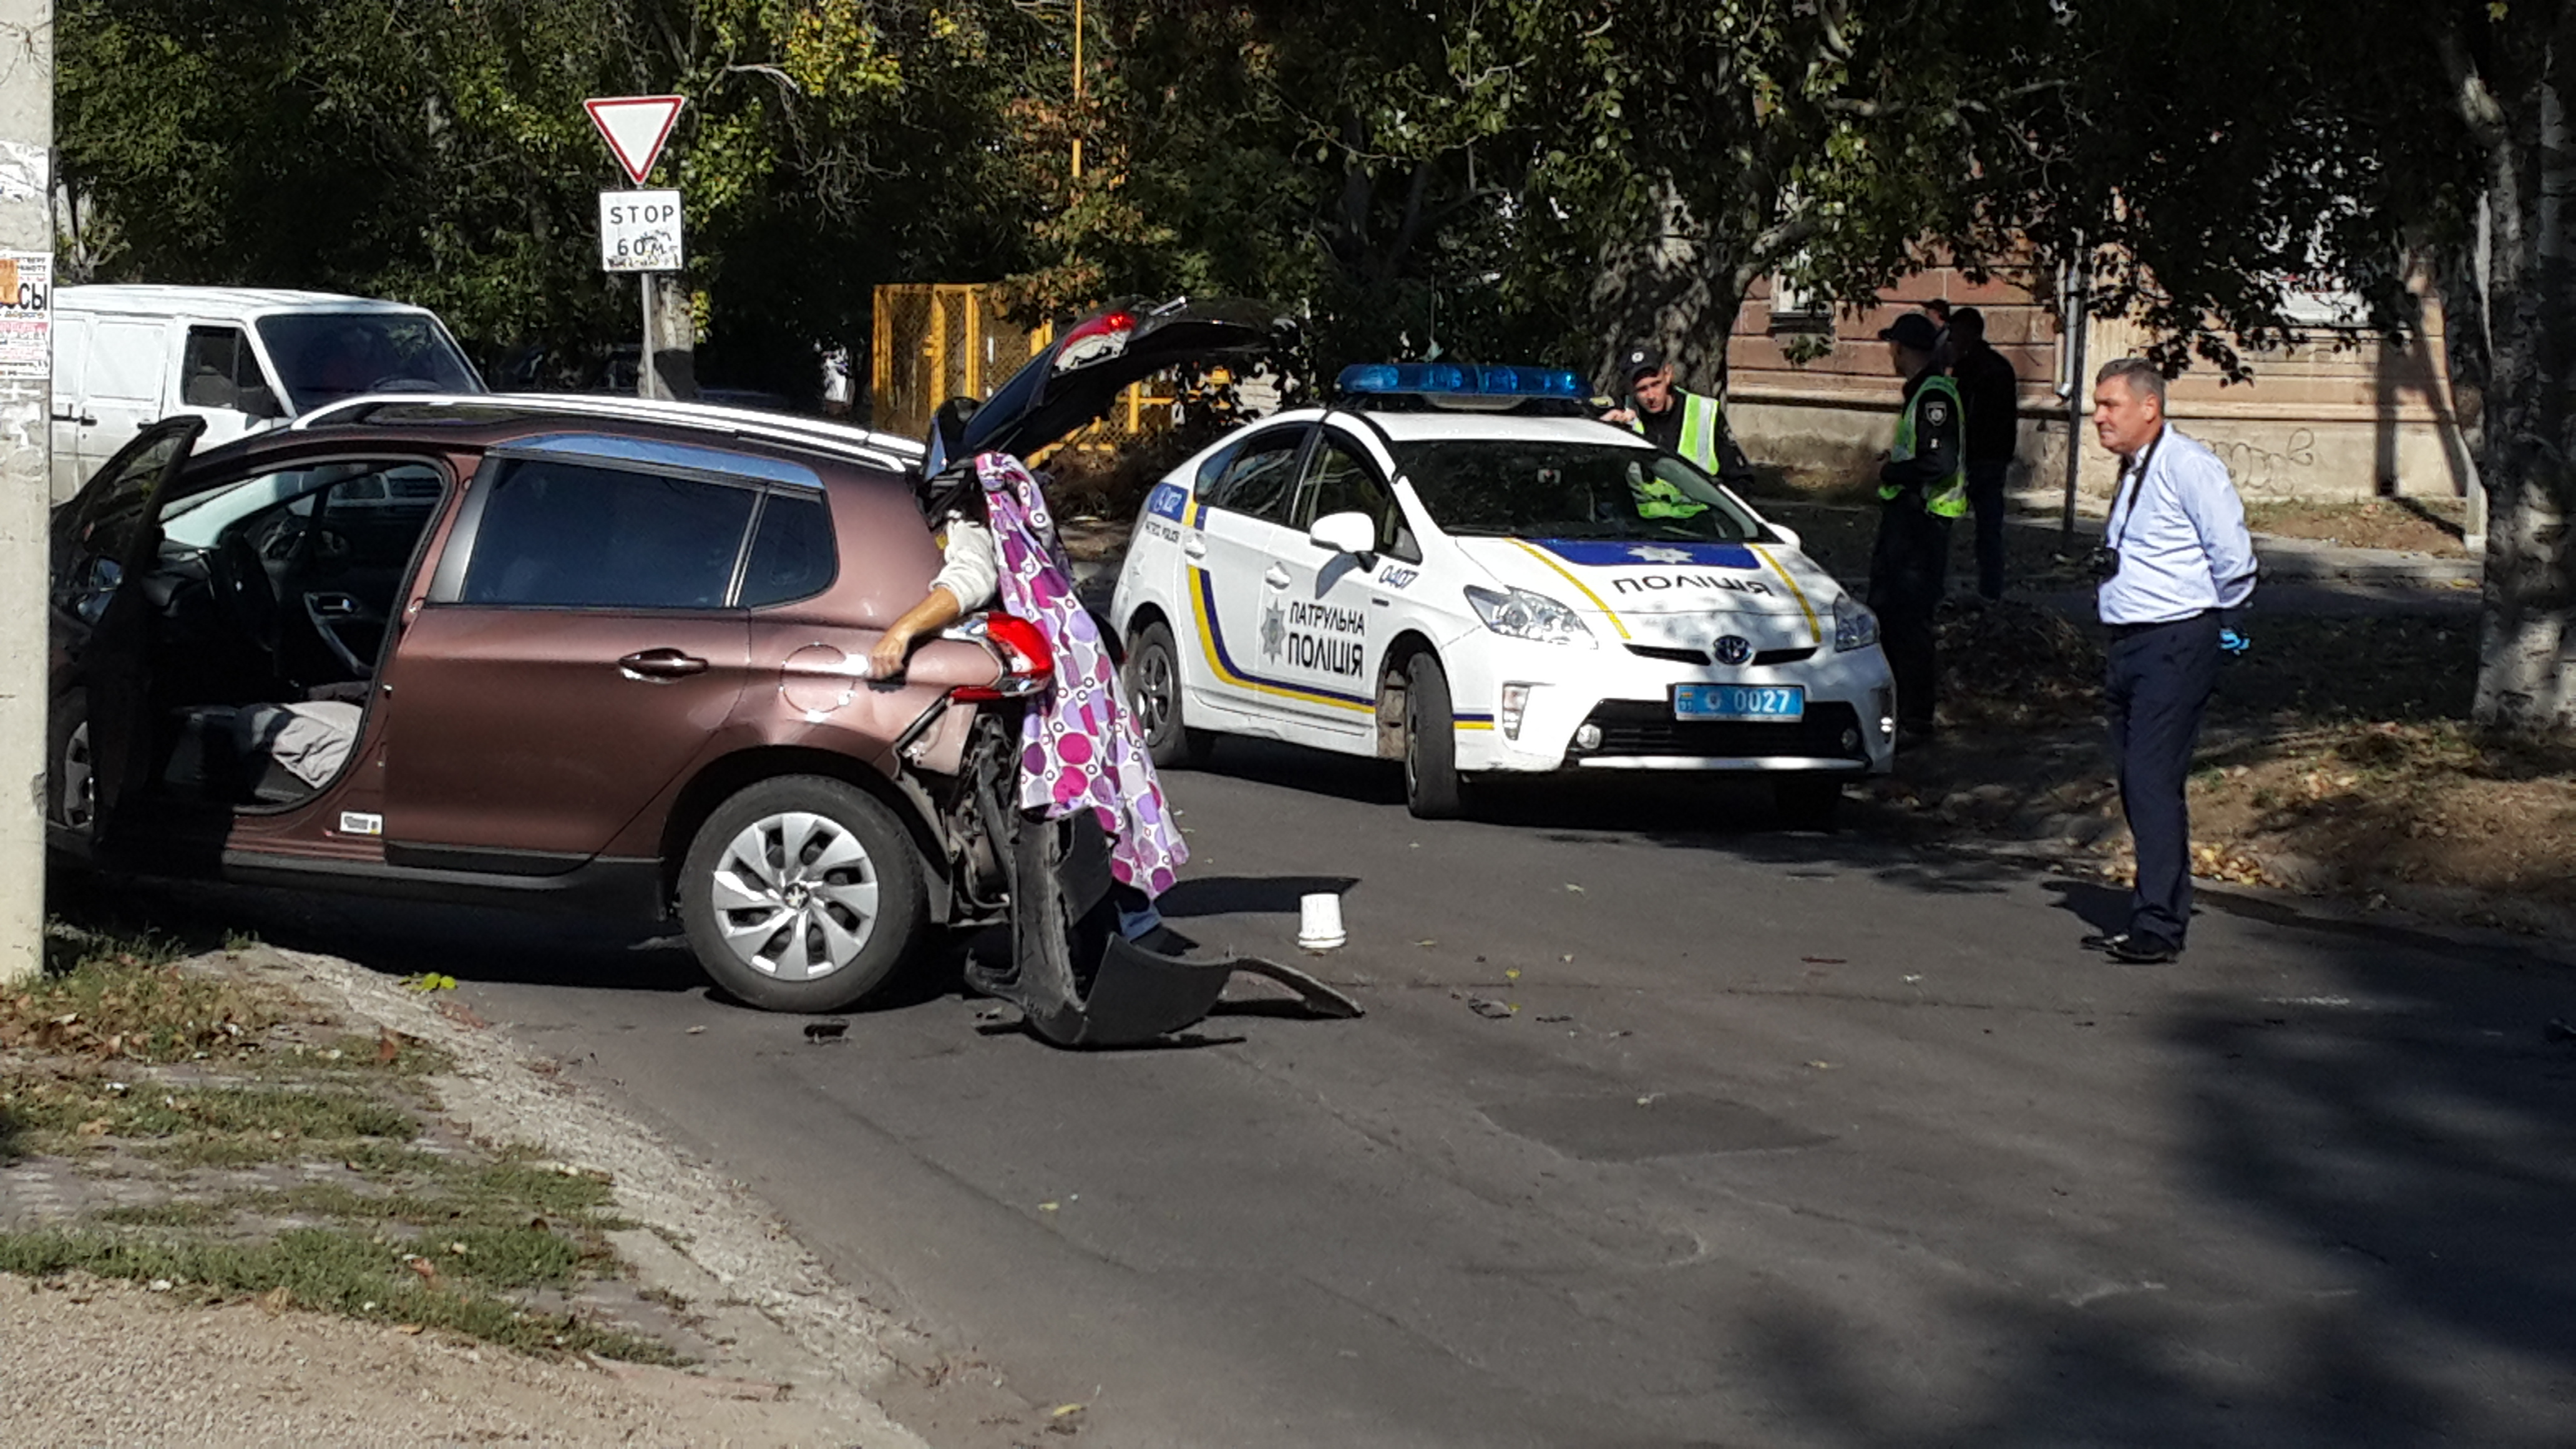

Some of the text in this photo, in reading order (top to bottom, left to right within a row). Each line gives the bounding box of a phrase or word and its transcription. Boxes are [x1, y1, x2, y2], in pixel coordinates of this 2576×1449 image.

[610, 205, 675, 224] STOP
[1612, 575, 1774, 596] ПОЛІЦІЯ
[1290, 601, 1365, 637] ПАТРУЛЬНА
[1289, 632, 1362, 678] ПОЛІЦІЯ
[1734, 690, 1791, 713] 0027
